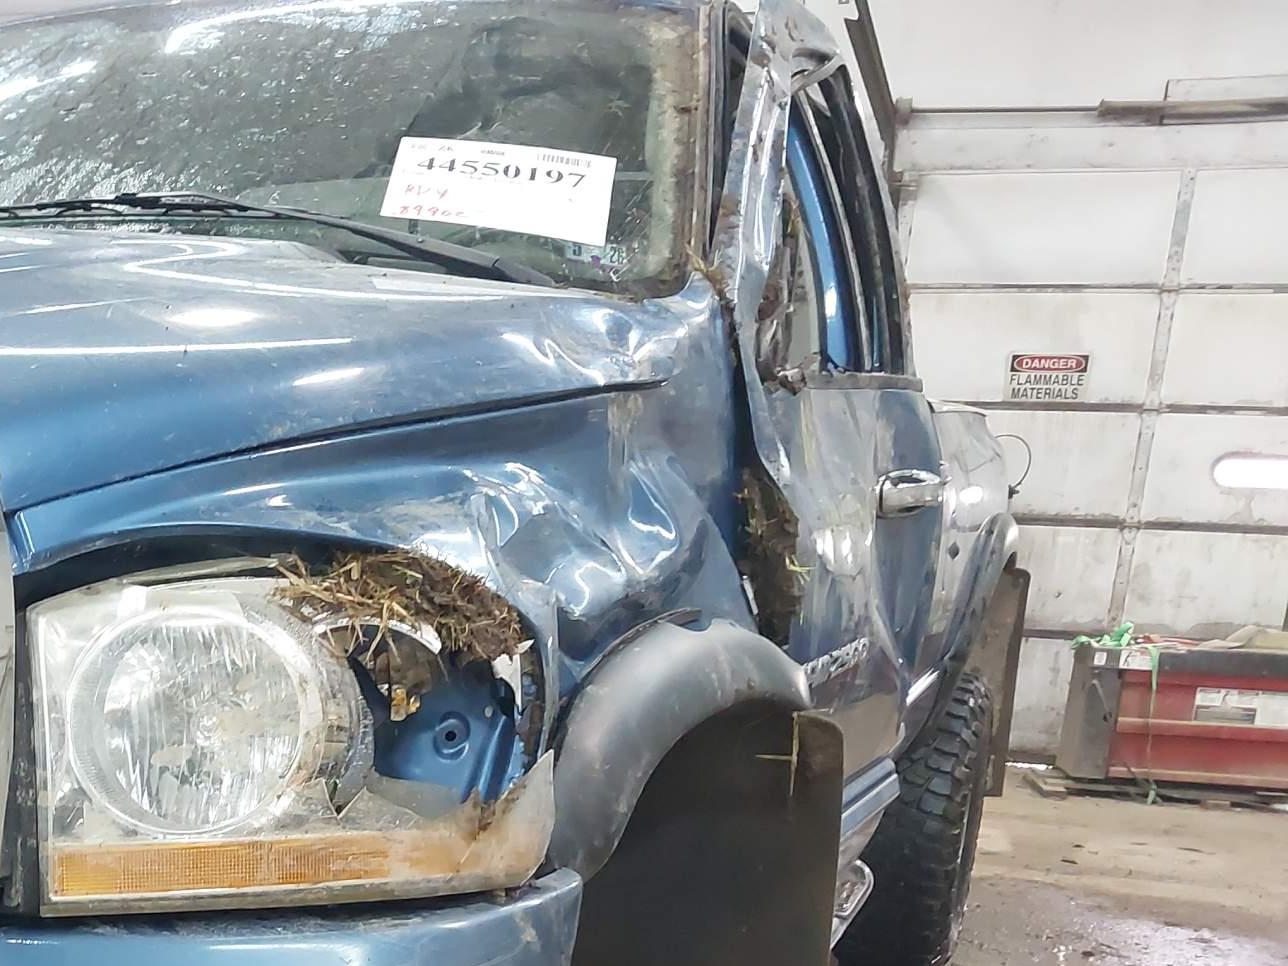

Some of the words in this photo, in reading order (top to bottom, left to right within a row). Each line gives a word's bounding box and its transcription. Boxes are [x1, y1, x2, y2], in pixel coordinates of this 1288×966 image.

[417, 157, 587, 188] 44550197
[1022, 358, 1077, 369] DANGER
[1009, 374, 1085, 386] FLAMMABLE
[1010, 387, 1079, 400] MATERIALS
